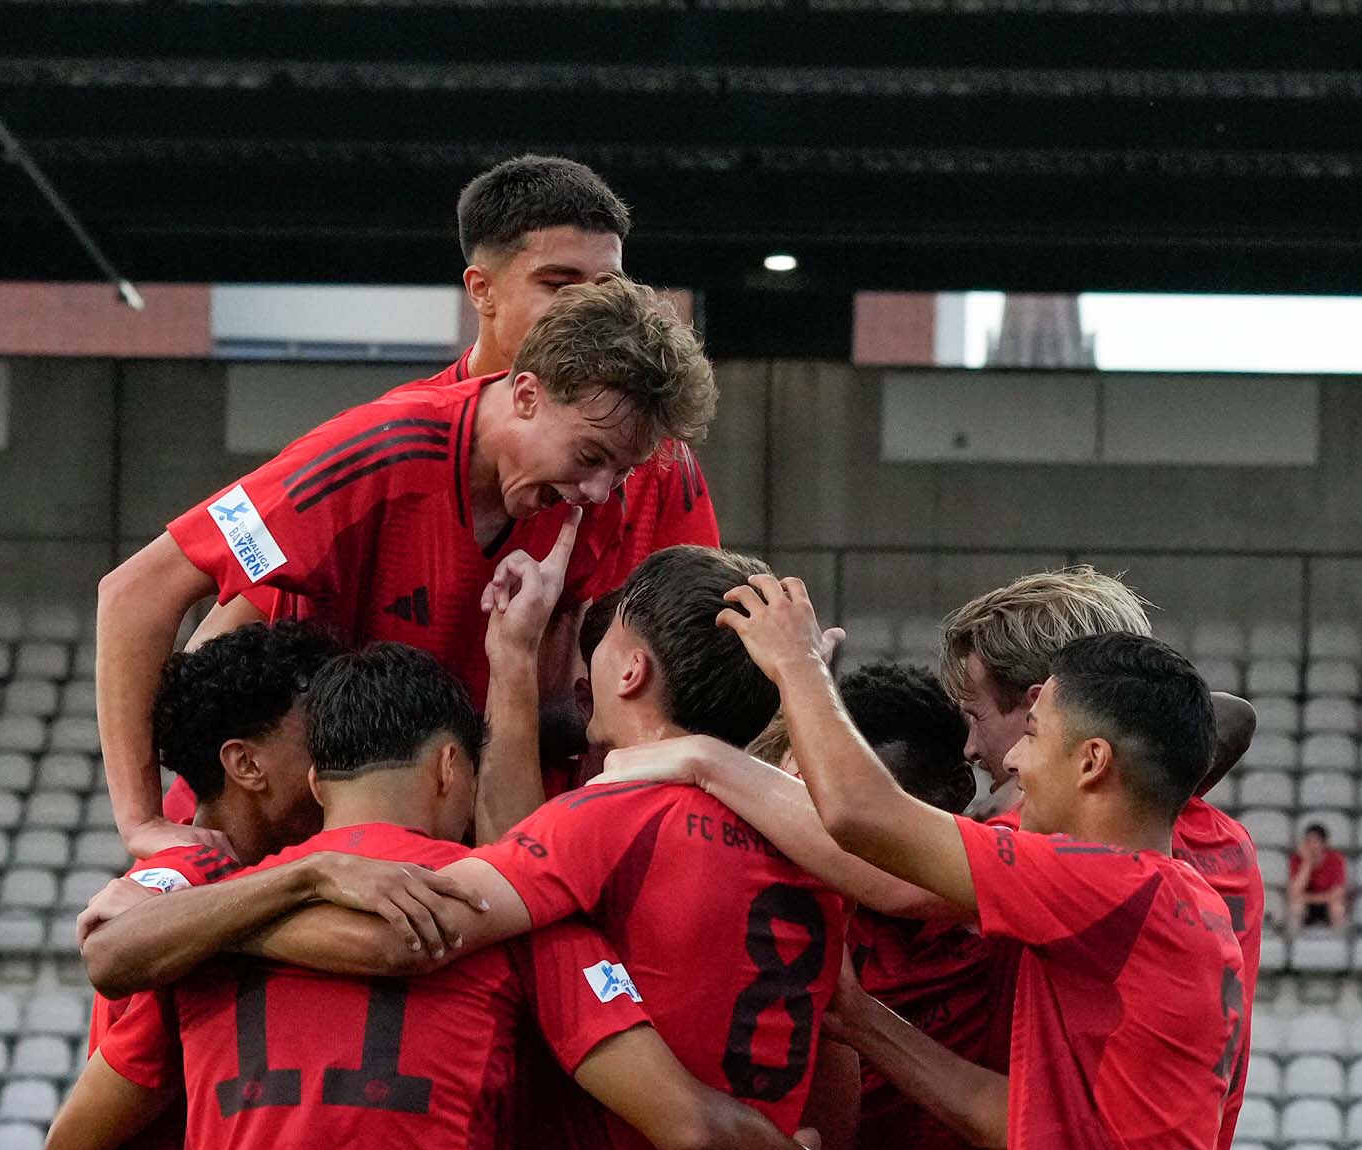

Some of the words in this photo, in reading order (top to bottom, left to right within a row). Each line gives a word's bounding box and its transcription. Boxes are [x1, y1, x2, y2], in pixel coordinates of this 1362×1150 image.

[229, 526, 264, 577] BAYERN
[687, 813, 714, 841] FC
[722, 882, 826, 1103] 8
[215, 970, 433, 1118] 11
